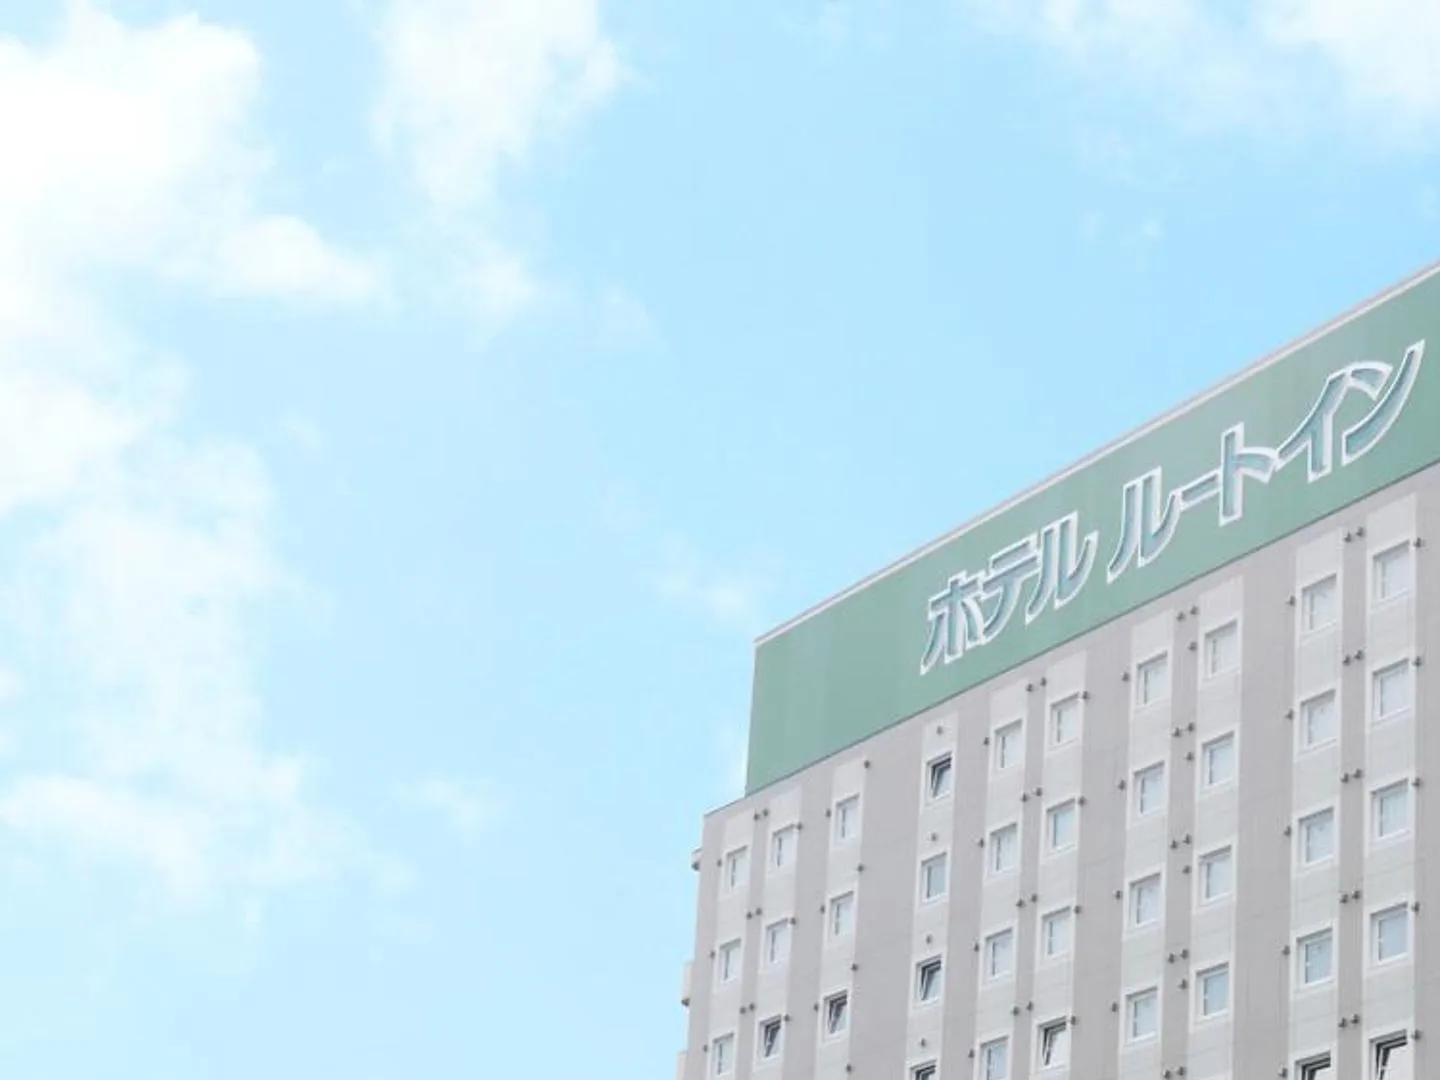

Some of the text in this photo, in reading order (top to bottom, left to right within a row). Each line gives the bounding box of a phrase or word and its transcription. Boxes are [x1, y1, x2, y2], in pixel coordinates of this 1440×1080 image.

[920, 339, 1426, 676] ホテル ルートイン
